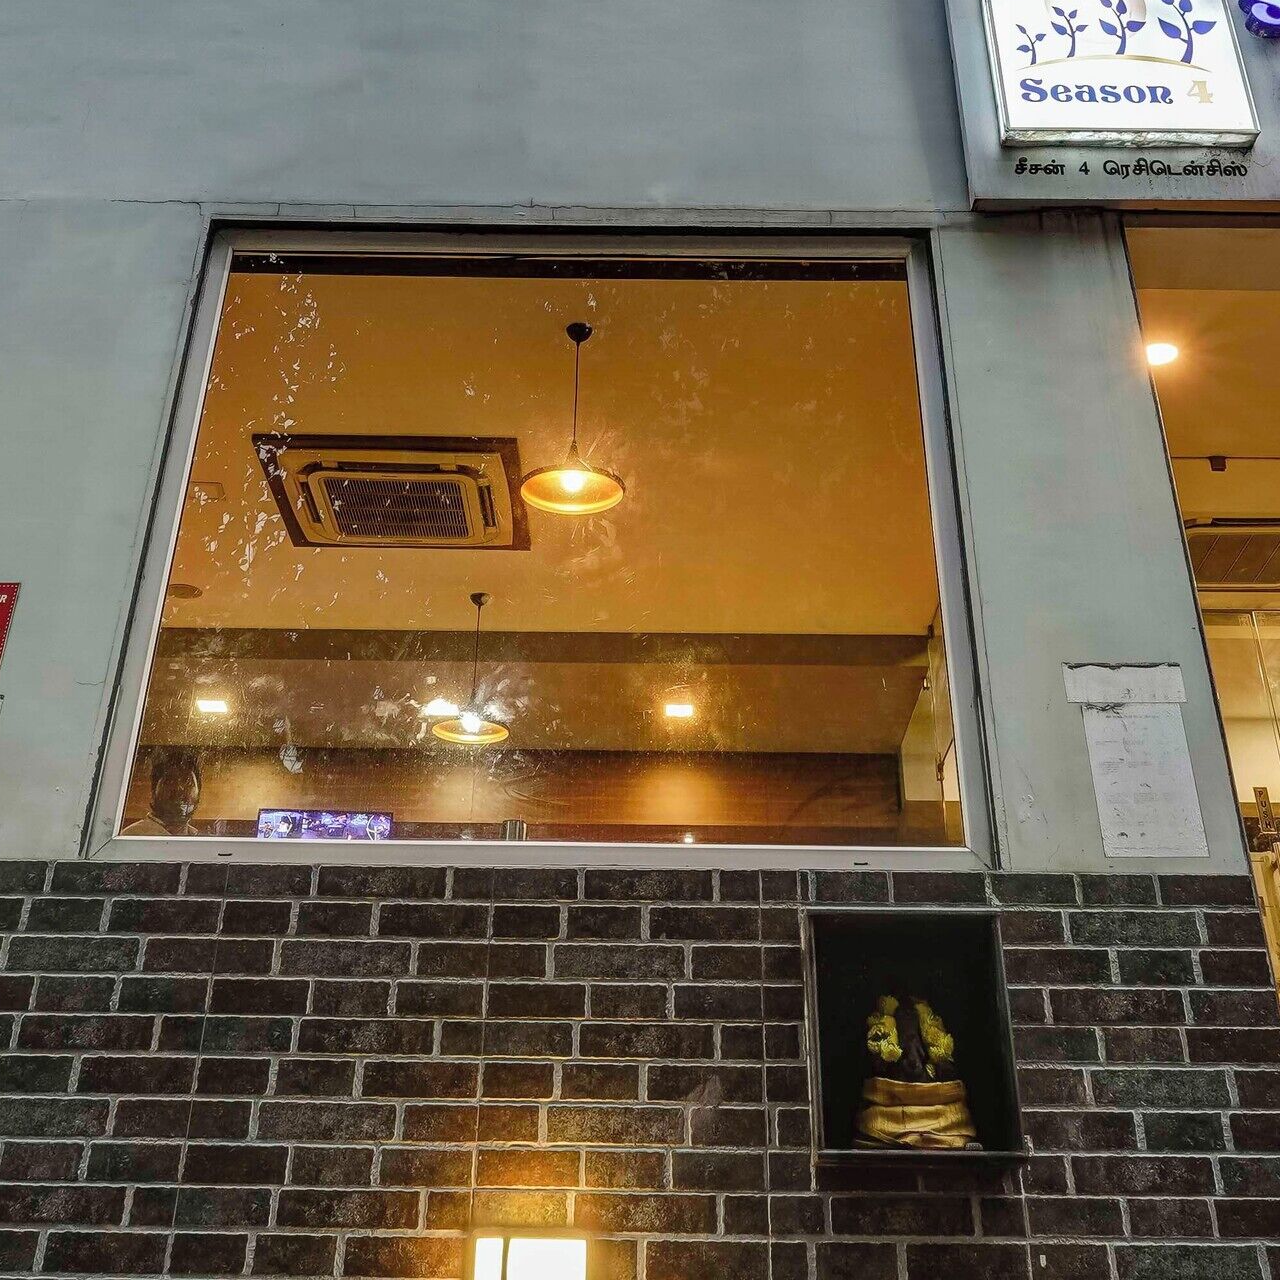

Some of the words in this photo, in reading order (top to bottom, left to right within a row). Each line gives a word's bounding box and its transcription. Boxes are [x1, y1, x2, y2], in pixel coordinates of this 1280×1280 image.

[1019, 78, 1174, 105] Season
[1186, 79, 1214, 104] 4
[1078, 161, 1091, 176] 4
